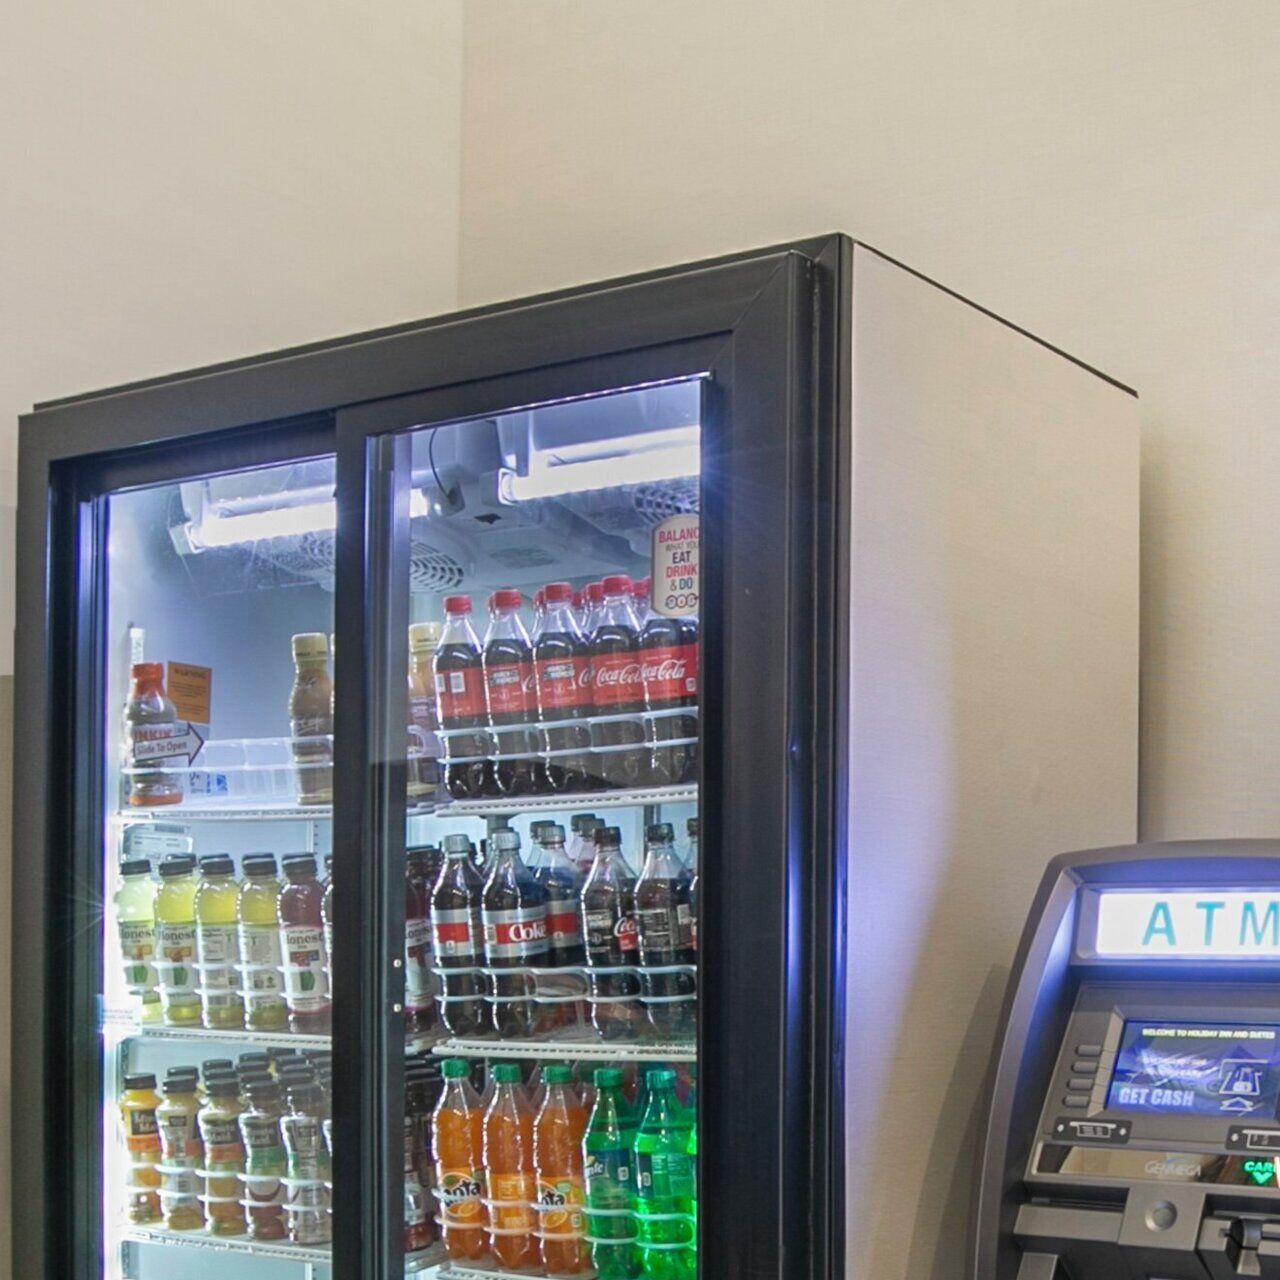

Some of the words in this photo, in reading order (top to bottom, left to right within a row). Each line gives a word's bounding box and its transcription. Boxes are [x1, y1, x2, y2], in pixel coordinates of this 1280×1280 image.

[672, 550, 692, 564] EAT
[666, 563, 698, 579] DRINK
[670, 580, 677, 591] &
[679, 577, 693, 590] DO
[137, 743, 157, 755] Slide
[157, 742, 166, 752] To
[166, 740, 187, 753] Open
[1141, 901, 1280, 946] ATM
[508, 922, 547, 943] Coke
[1142, 1028, 1175, 1037] WELCOME
[1177, 1029, 1187, 1037] TO
[1187, 1029, 1217, 1038] HOLIDAY
[1218, 1030, 1233, 1038] INN
[1233, 1031, 1248, 1039] AND
[1119, 1088, 1149, 1105] GET
[1151, 1089, 1196, 1106] CASH
[1244, 1161, 1276, 1173] CAR
